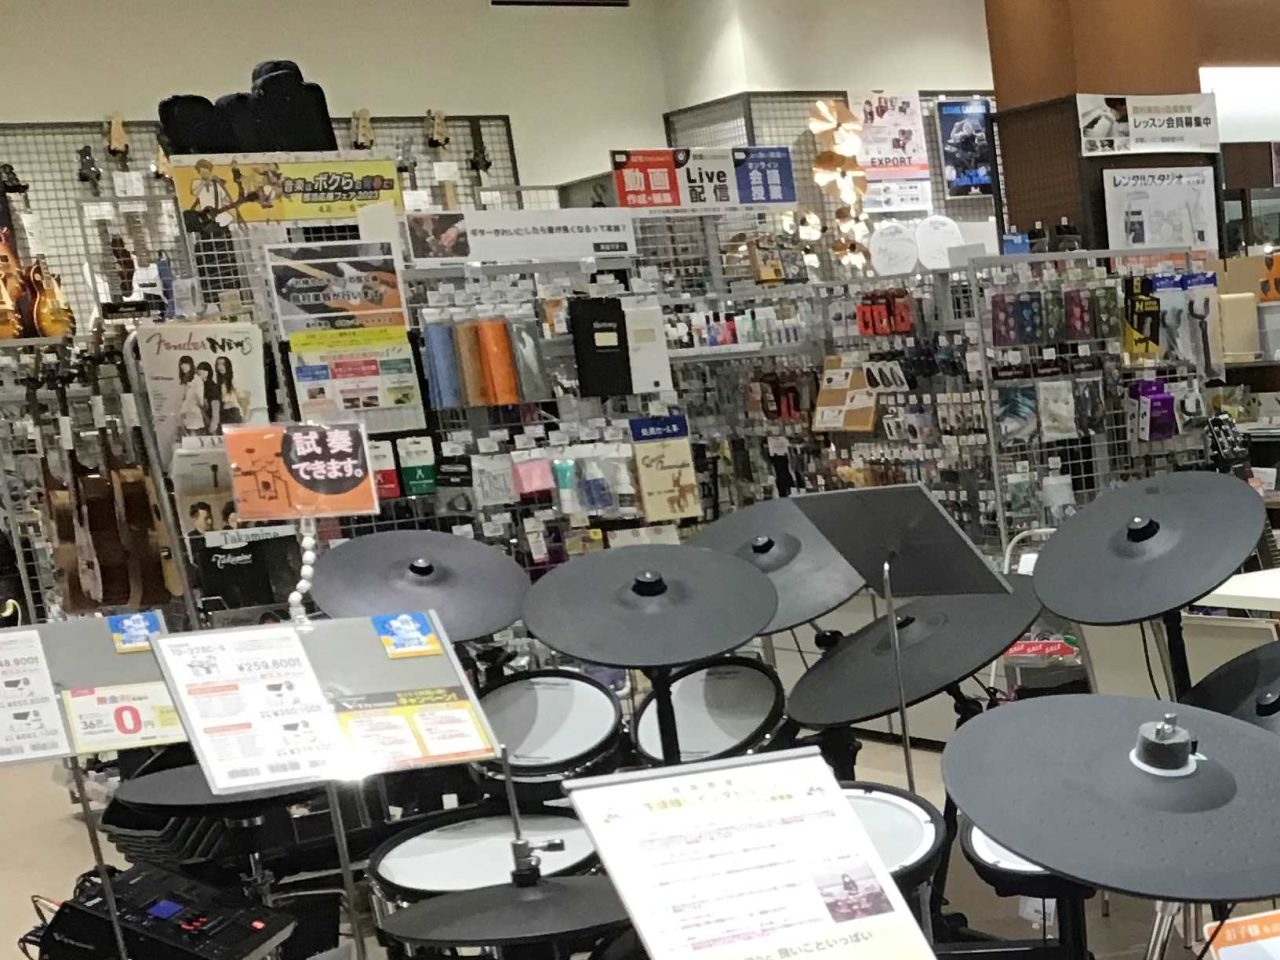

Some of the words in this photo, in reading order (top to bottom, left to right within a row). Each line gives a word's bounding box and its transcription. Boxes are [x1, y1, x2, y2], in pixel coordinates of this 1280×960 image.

[870, 156, 913, 167] EXPORT
[686, 167, 728, 184] Live
[688, 184, 731, 204] 配信
[291, 429, 353, 456] 試奏
[291, 457, 364, 481] できます。
[220, 529, 280, 546] Takamine
